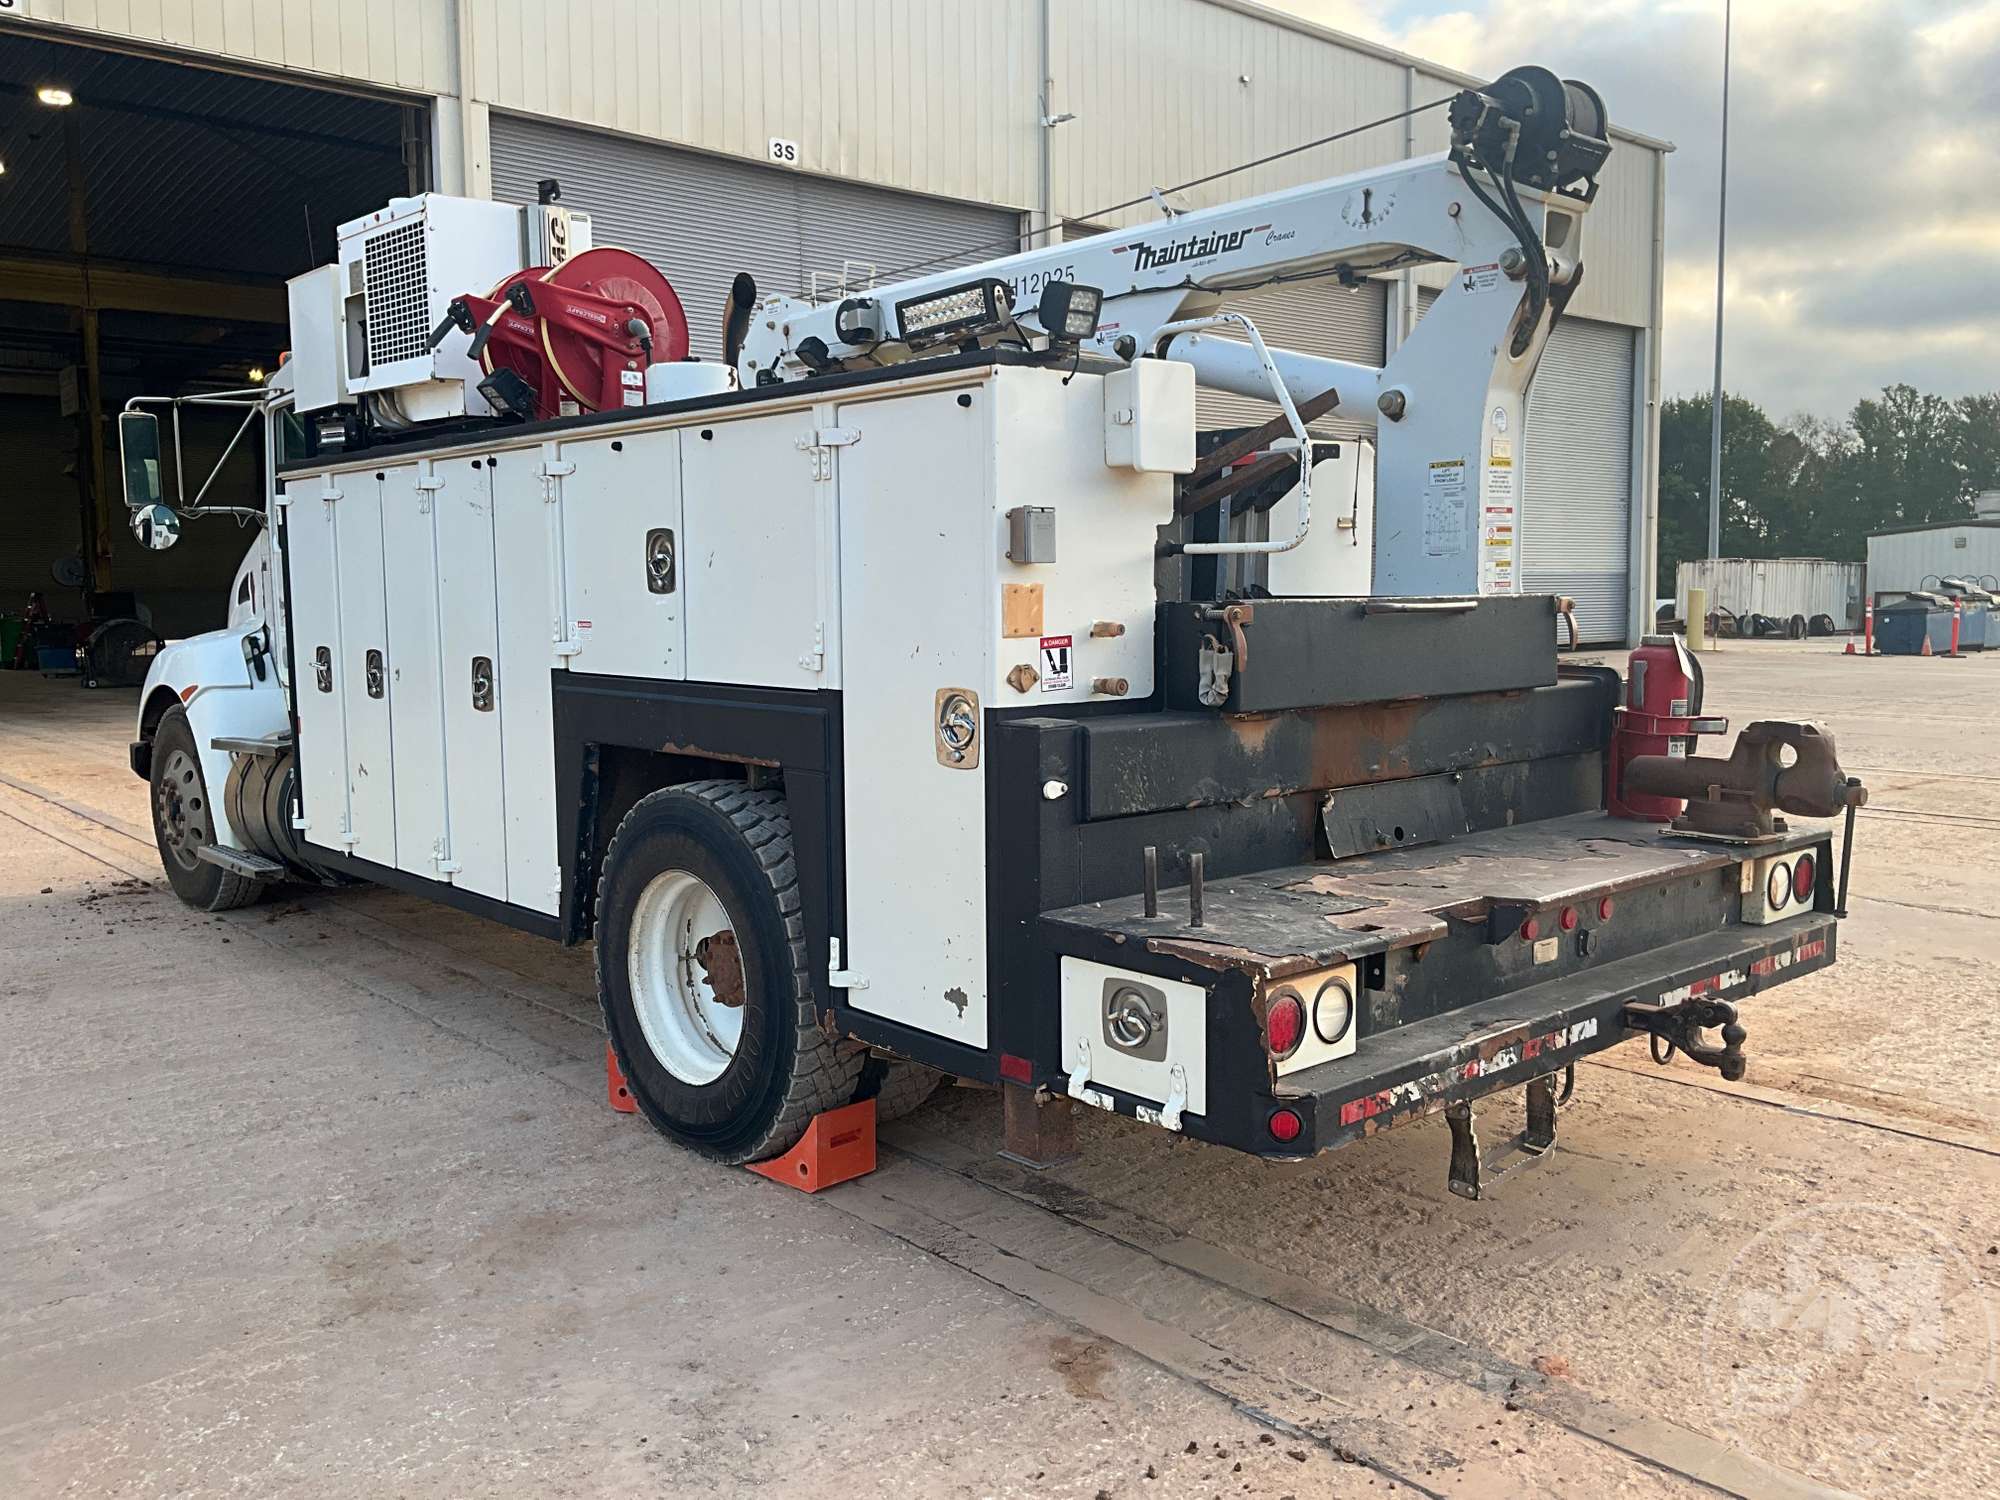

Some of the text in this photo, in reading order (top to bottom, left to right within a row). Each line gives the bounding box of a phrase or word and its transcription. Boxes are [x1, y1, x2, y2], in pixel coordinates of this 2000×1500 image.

[774, 142, 795, 161] 3S
[1128, 228, 1296, 272] Maintainer Cranes
[1048, 638, 1069, 647] DANGER
